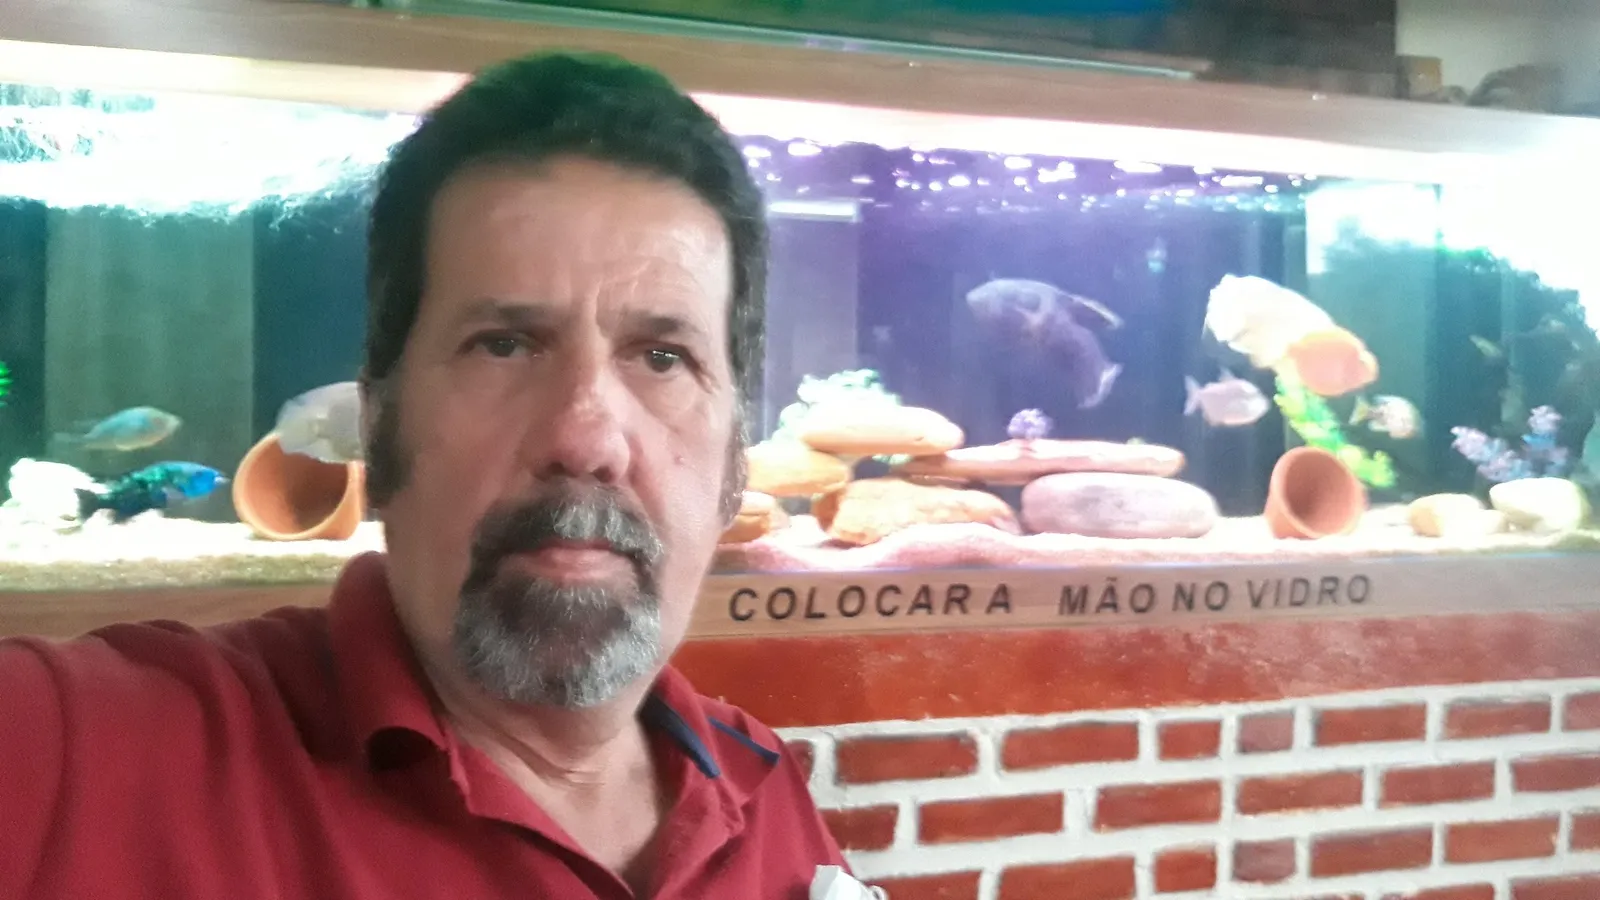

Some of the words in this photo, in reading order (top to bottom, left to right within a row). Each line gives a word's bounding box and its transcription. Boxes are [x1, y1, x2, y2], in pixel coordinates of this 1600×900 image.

[729, 584, 972, 621] COLOCAR
[986, 583, 1013, 614] A
[1058, 576, 1156, 615] MÃO
[1172, 580, 1230, 612] NO
[1247, 574, 1372, 608] VIDRO
